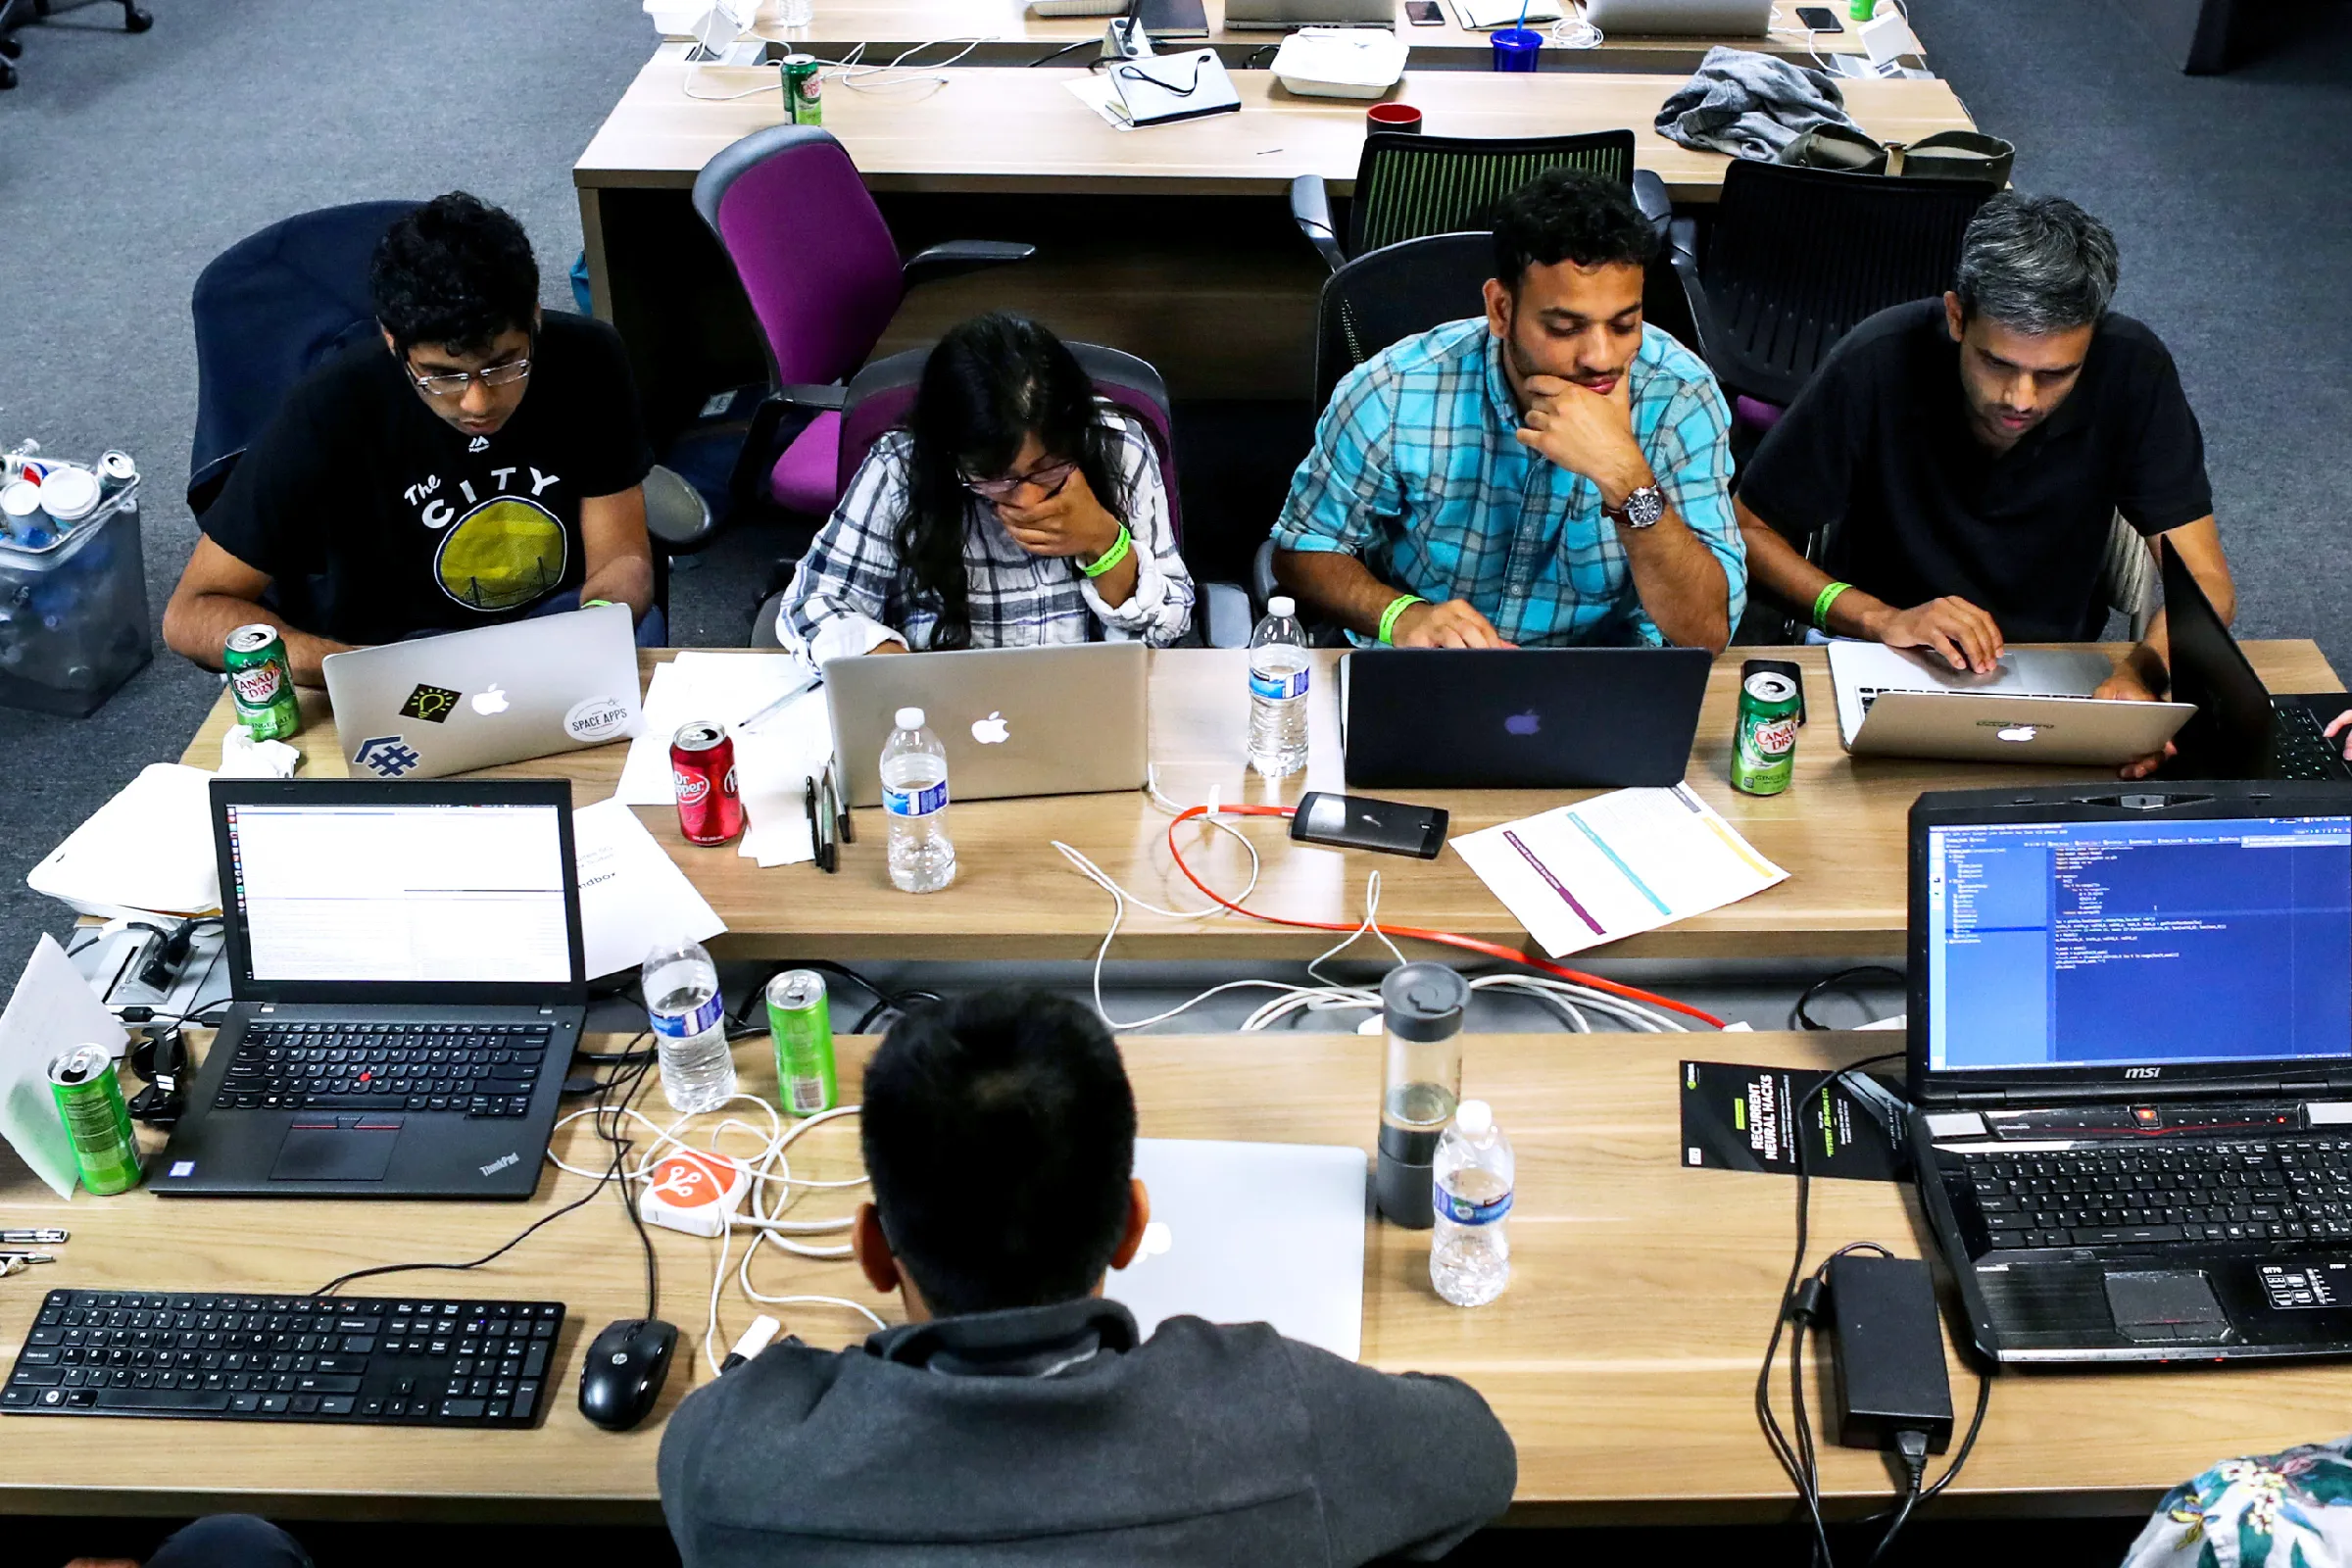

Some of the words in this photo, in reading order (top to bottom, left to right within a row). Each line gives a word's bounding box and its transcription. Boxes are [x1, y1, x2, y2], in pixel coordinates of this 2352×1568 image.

[404, 474, 441, 506] The
[421, 466, 561, 529] CITY
[249, 681, 274, 699] DRY
[572, 715, 601, 732] SPACE
[604, 709, 627, 723] APPS
[1772, 734, 1794, 751] DRY
[2125, 1067, 2161, 1079] msi
[1760, 1074, 1775, 1112] HACKS
[1748, 1082, 1764, 1151] RECURRENT
[1763, 1113, 1779, 1160] NEURAL
[479, 1152, 519, 1176] ThinkPad
